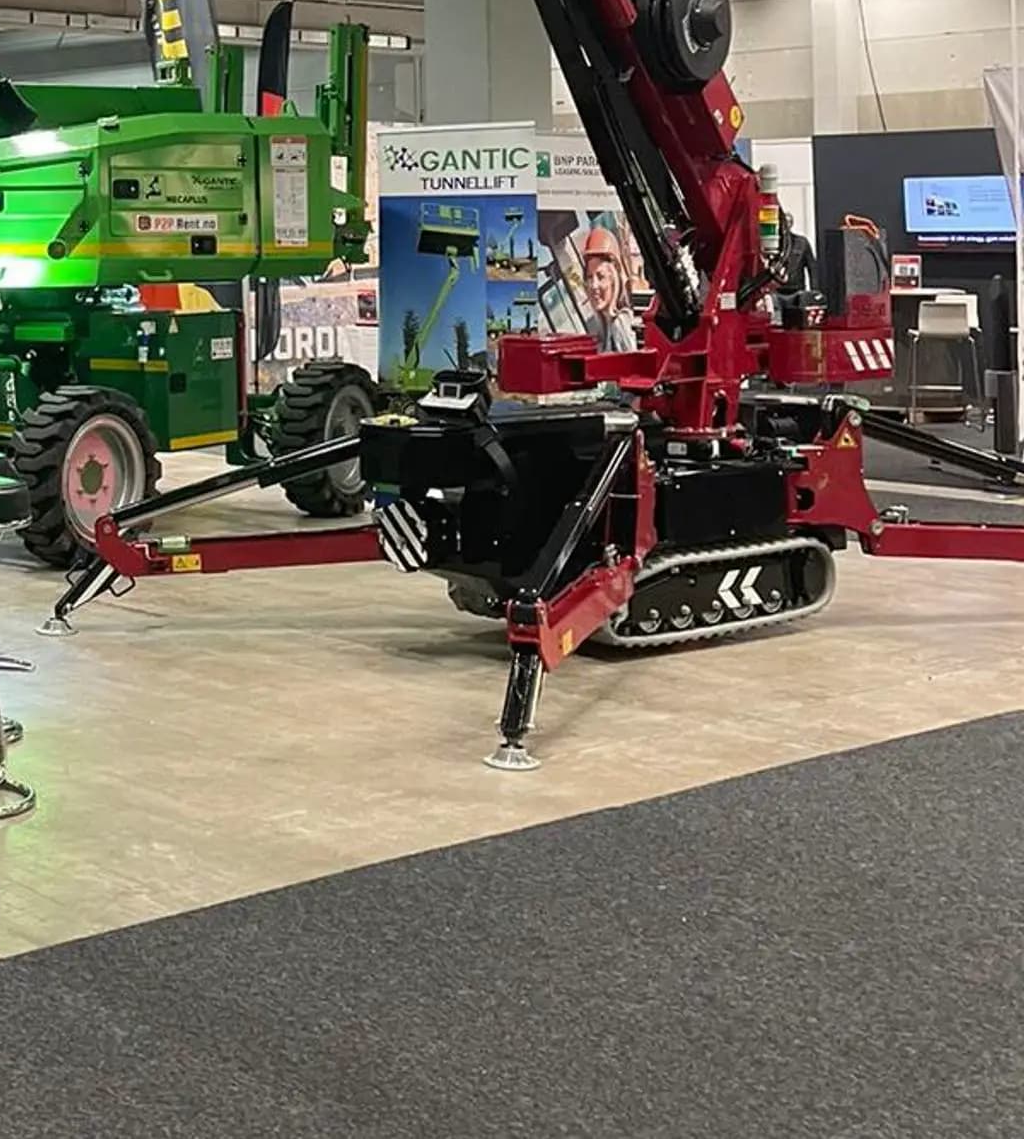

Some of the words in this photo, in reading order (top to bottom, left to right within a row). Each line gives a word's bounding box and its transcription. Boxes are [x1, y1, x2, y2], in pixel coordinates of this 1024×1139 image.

[419, 147, 530, 172] GANTIC
[420, 176, 519, 190] TUNNELLIFT
[154, 216, 174, 229] P2P
[176, 217, 216, 229] Rent.no
